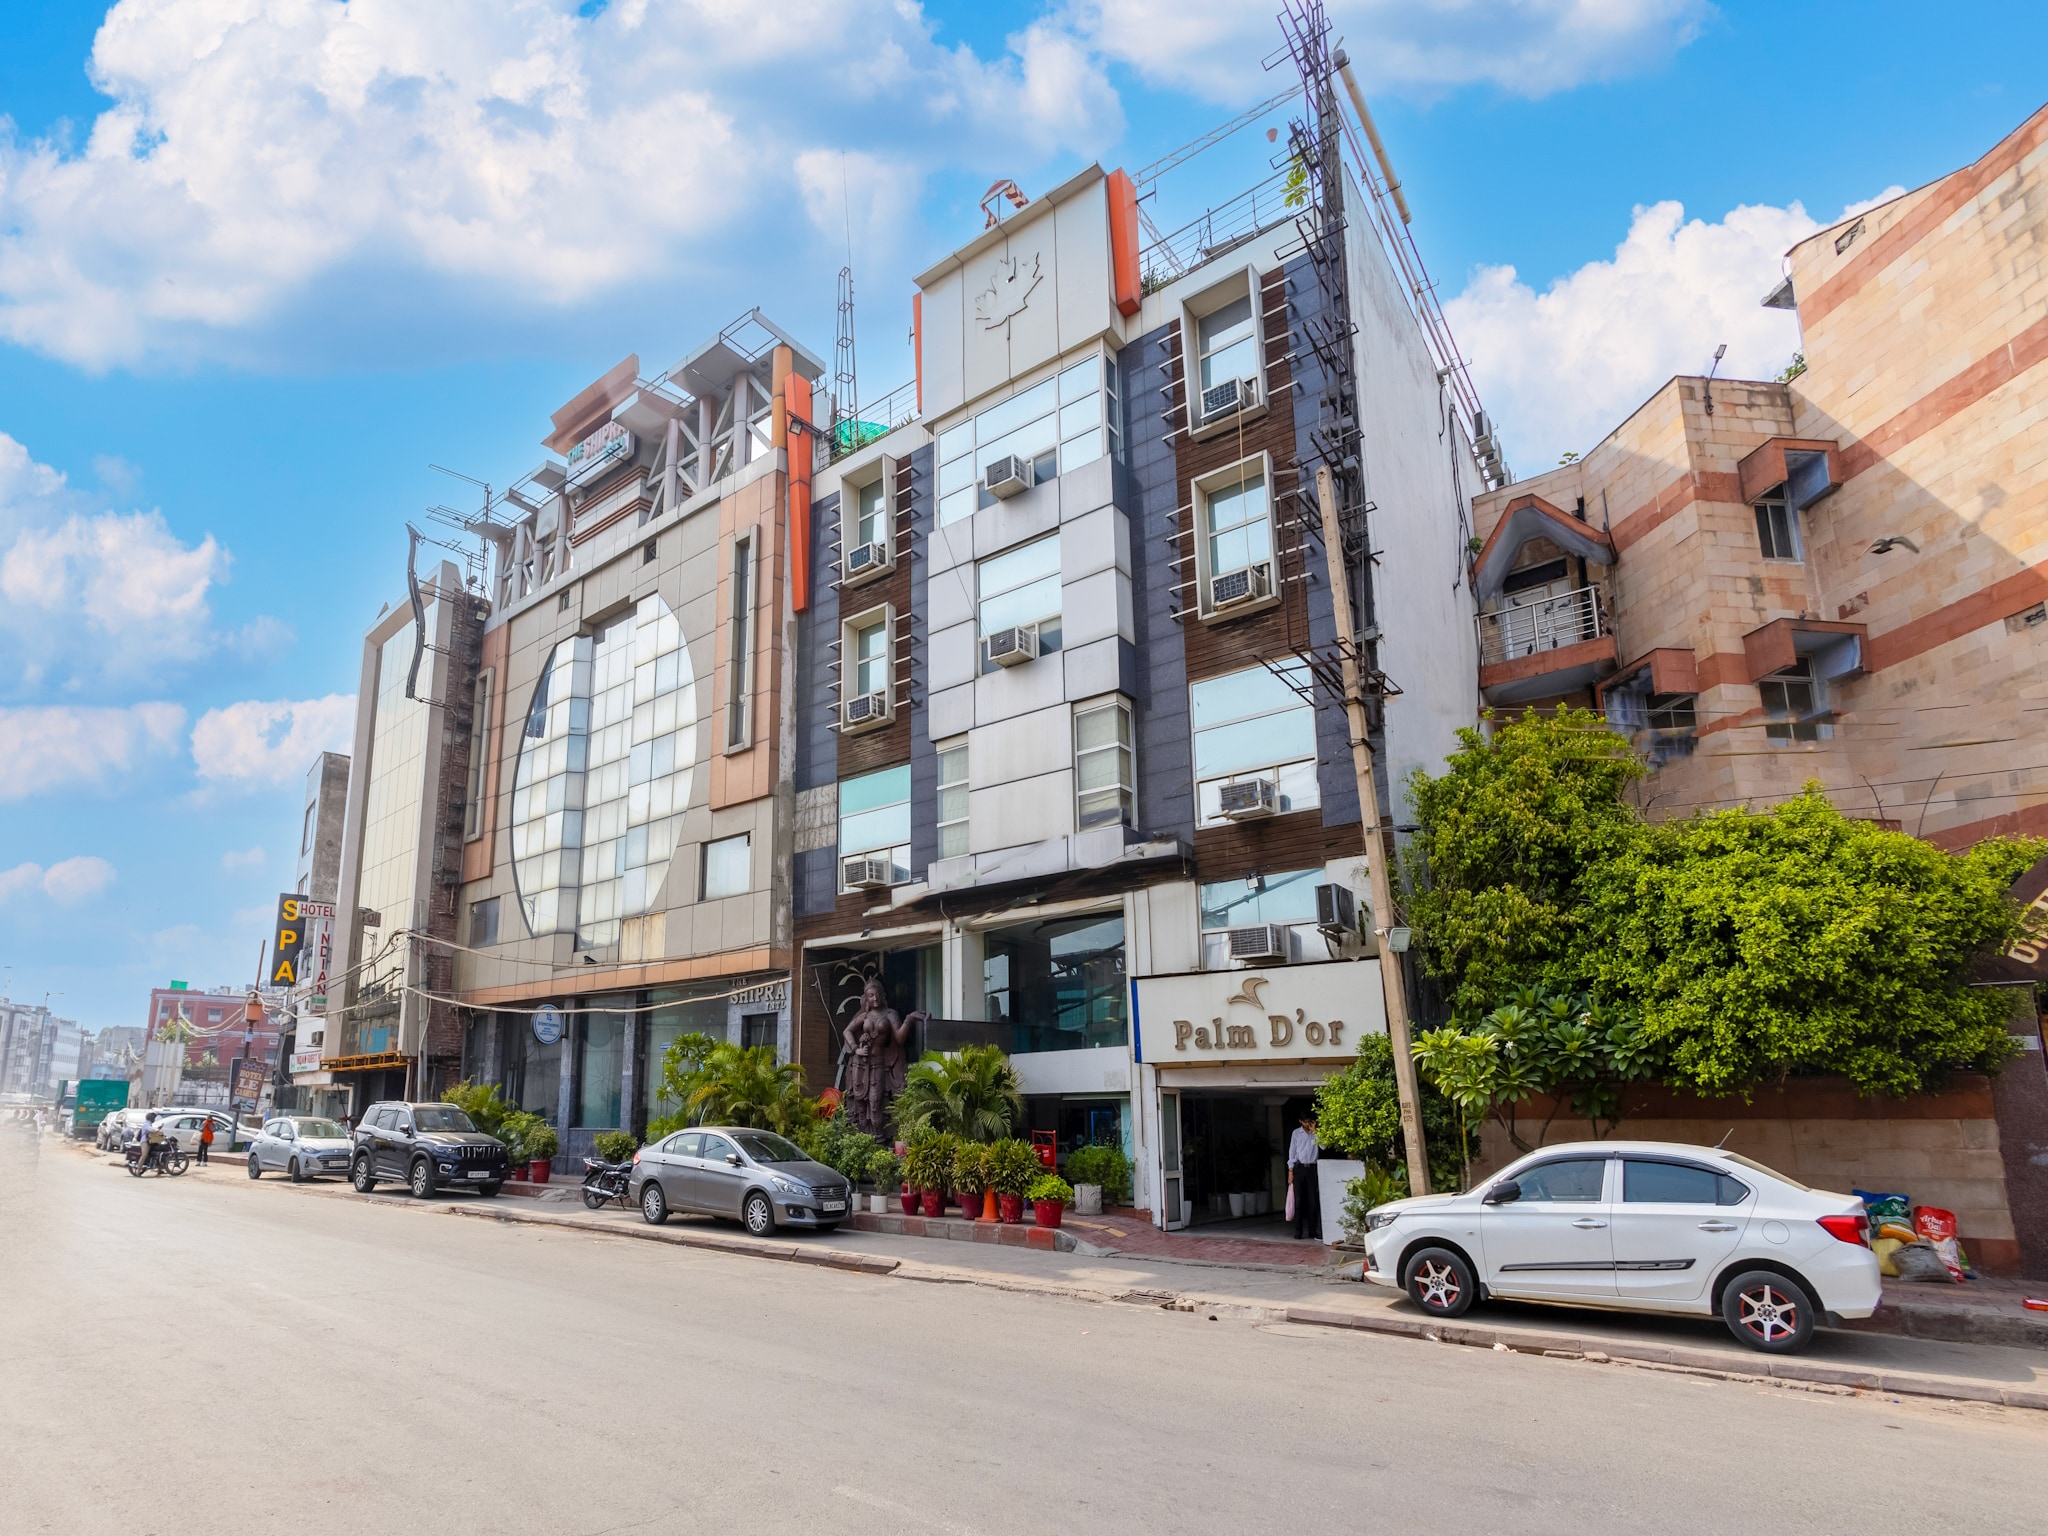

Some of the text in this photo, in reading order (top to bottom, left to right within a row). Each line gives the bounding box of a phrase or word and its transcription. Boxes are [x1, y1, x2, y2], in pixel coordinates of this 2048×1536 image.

[300, 904, 335, 917] HOTEL
[274, 899, 298, 983] SPA
[317, 920, 330, 995] INDIAN
[731, 977, 748, 987] THE
[730, 983, 786, 1005] SHIPRA
[1173, 1008, 1344, 1050] Palm D'or
[239, 1069, 263, 1081] HOTEL
[238, 1078, 259, 1090] LE
